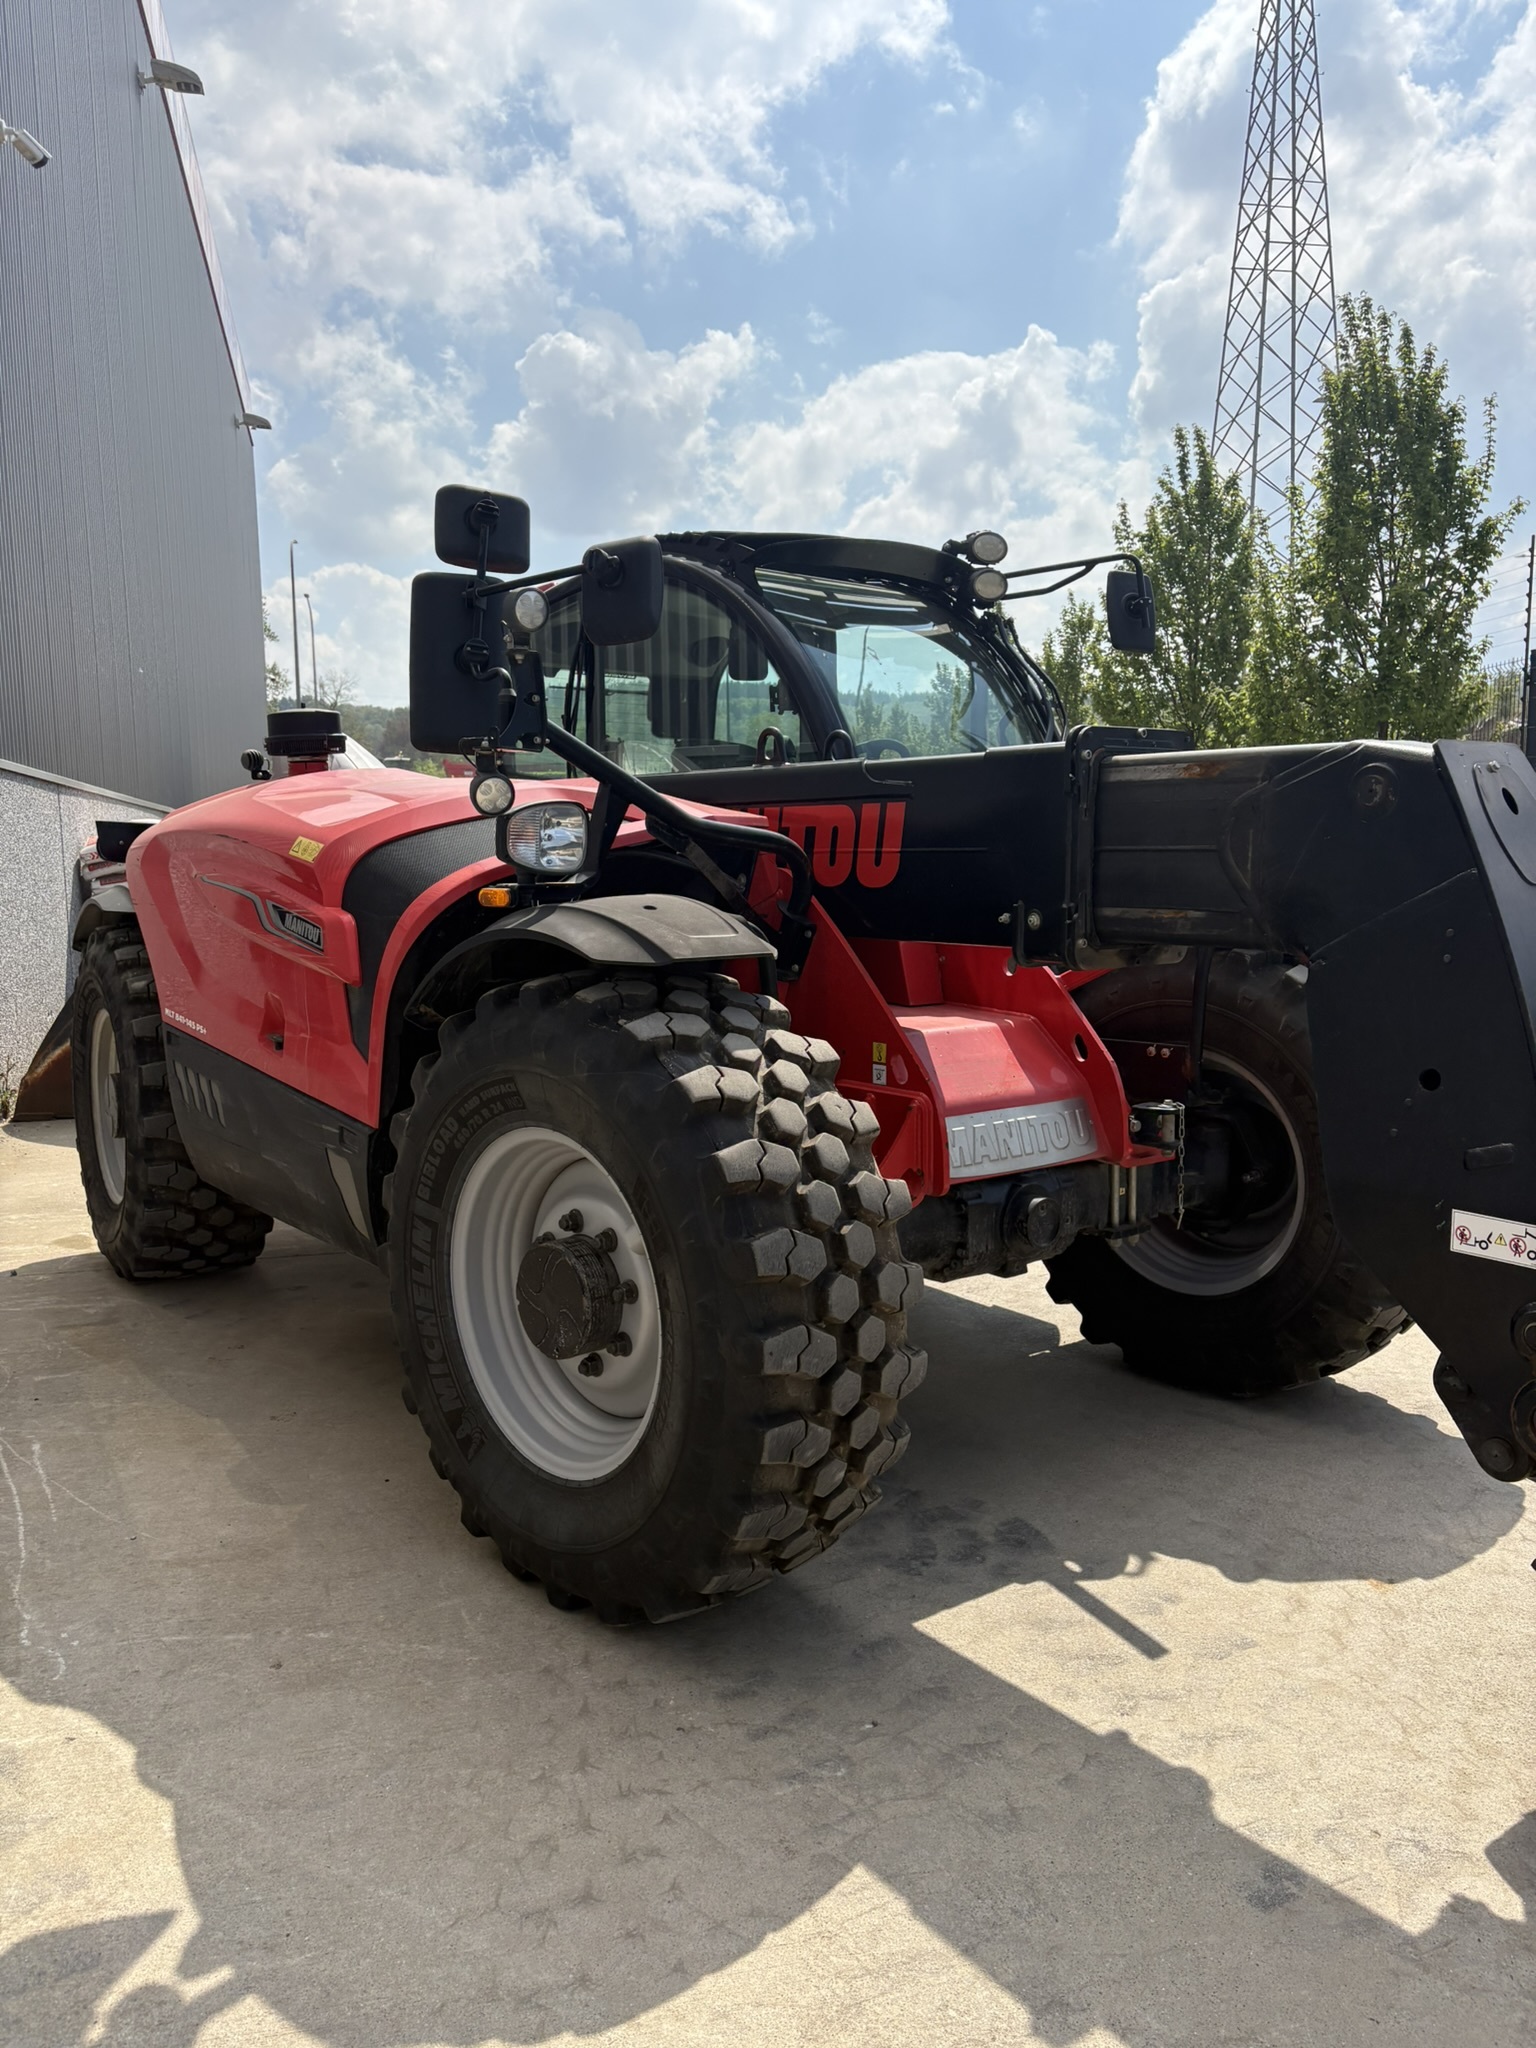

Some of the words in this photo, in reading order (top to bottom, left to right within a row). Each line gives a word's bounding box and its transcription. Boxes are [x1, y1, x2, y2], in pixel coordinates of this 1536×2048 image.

[284, 912, 321, 944] MANITOU
[164, 1007, 175, 1019] MLT
[458, 1095, 481, 1118] HARD
[479, 1083, 517, 1101] SURFACE
[480, 1108, 492, 1120] R
[950, 1109, 1092, 1167] MANITOU
[417, 1116, 459, 1201] BIBLOAD
[411, 1215, 464, 1413] MICHELIN
